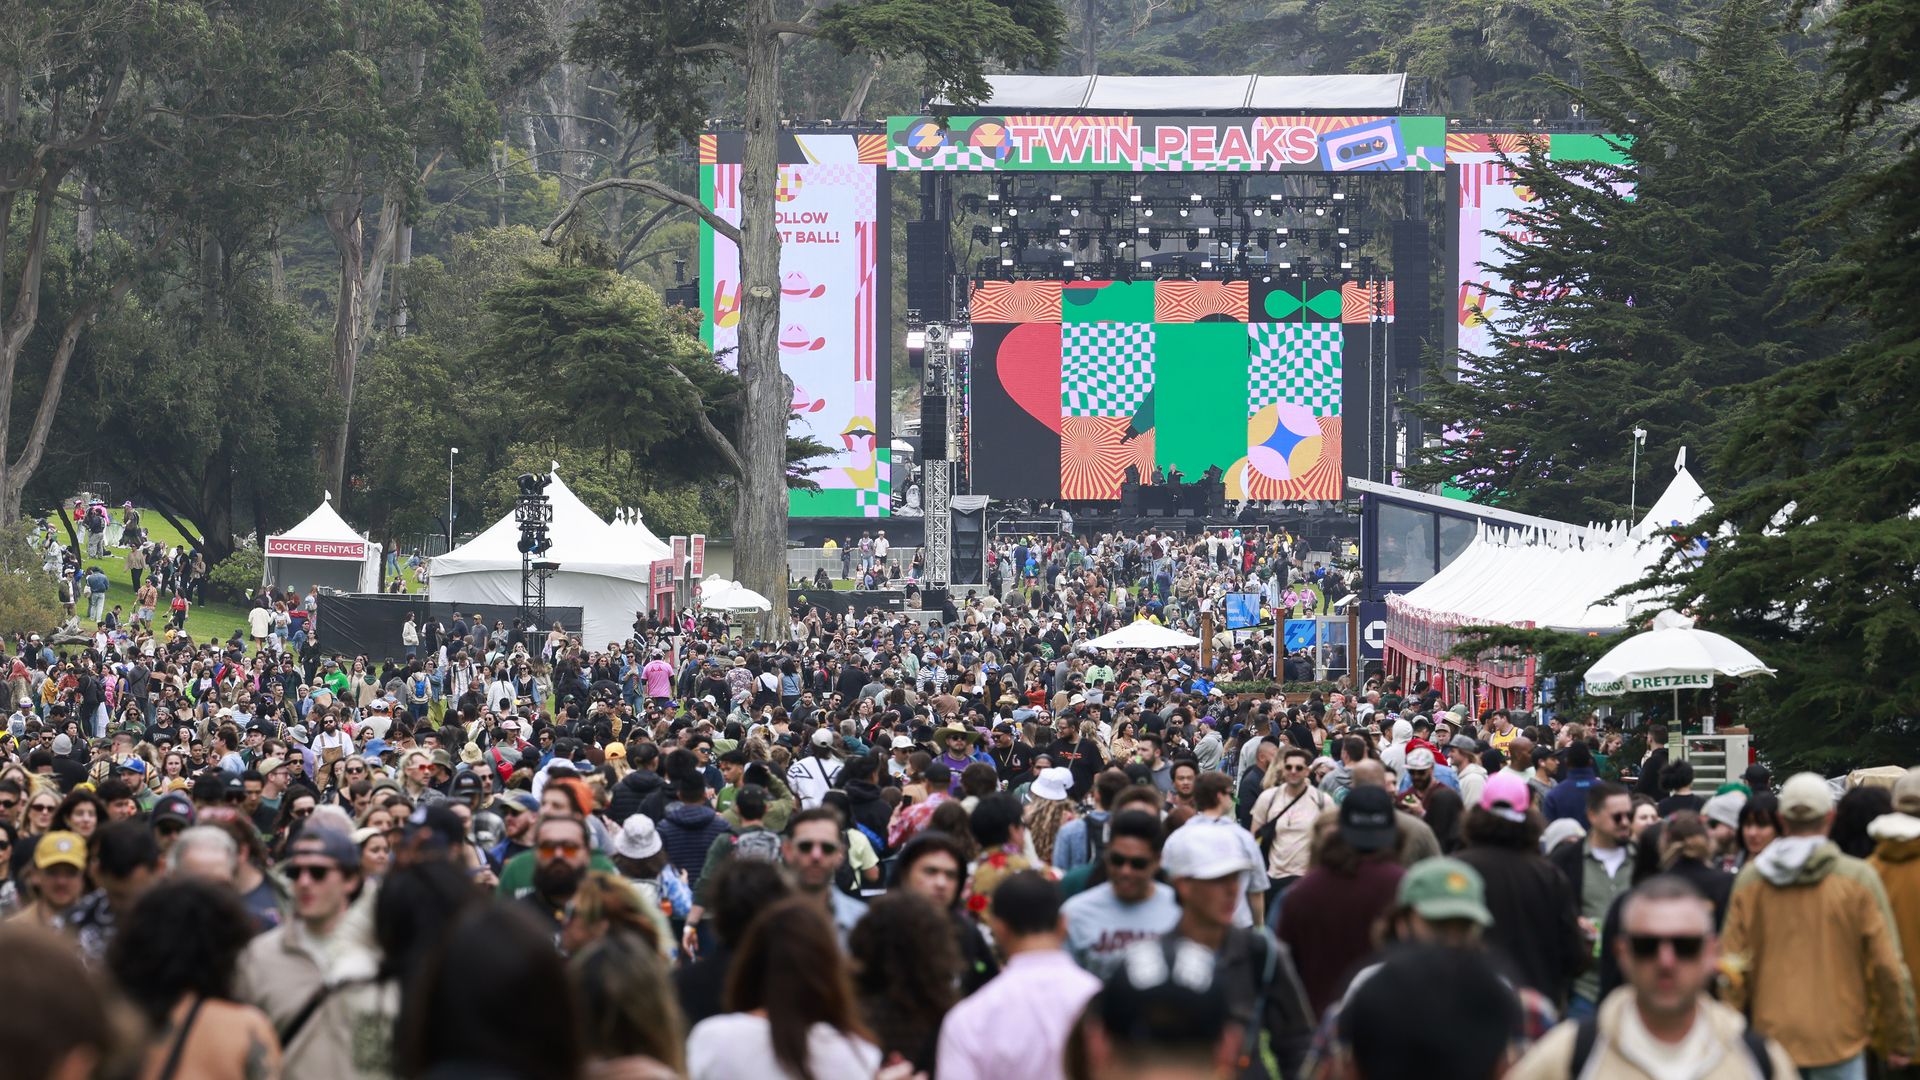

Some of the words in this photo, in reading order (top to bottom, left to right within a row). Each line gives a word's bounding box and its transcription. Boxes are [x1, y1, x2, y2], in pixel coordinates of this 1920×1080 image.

[1010, 126, 1139, 163] TWIN
[1155, 125, 1318, 164] PEAKS
[775, 211, 828, 224] OLLOW
[795, 231, 840, 243] BALL!
[269, 542, 311, 552] LOCKER
[315, 544, 364, 554] RENTALS
[1631, 674, 1709, 689] PRETZELS
